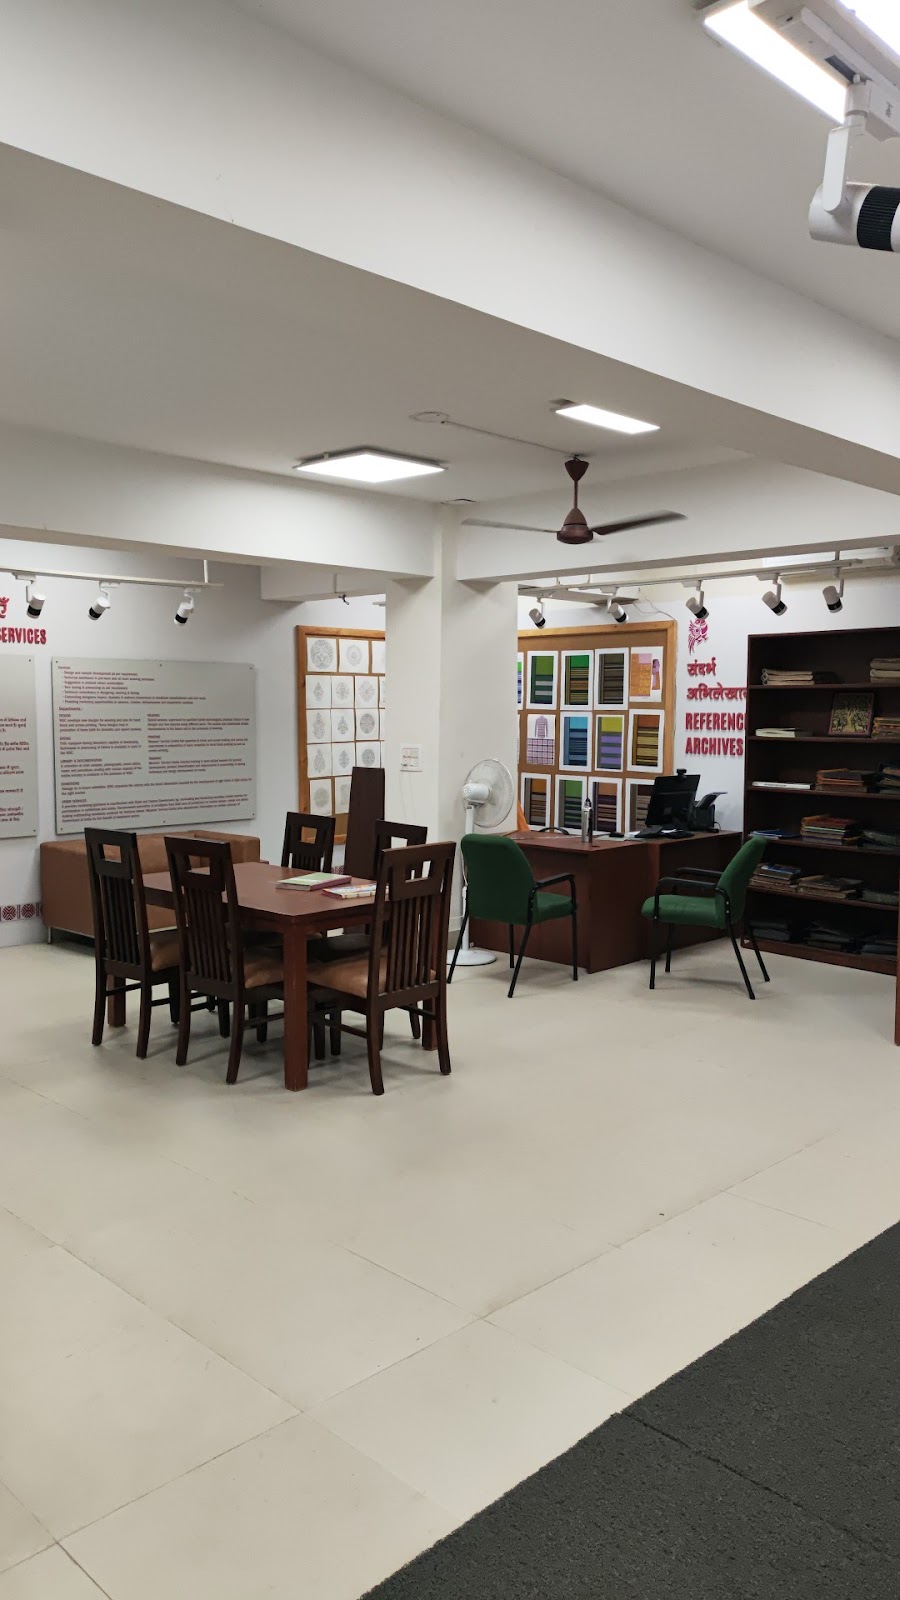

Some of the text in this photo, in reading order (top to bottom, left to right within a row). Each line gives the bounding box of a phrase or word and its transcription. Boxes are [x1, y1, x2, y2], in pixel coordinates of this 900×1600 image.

[0, 627, 47, 645] ERVICES
[687, 657, 716, 677] संदर्भ
[685, 712, 746, 731] REFERENC
[685, 737, 744, 757] ARCHIVES
